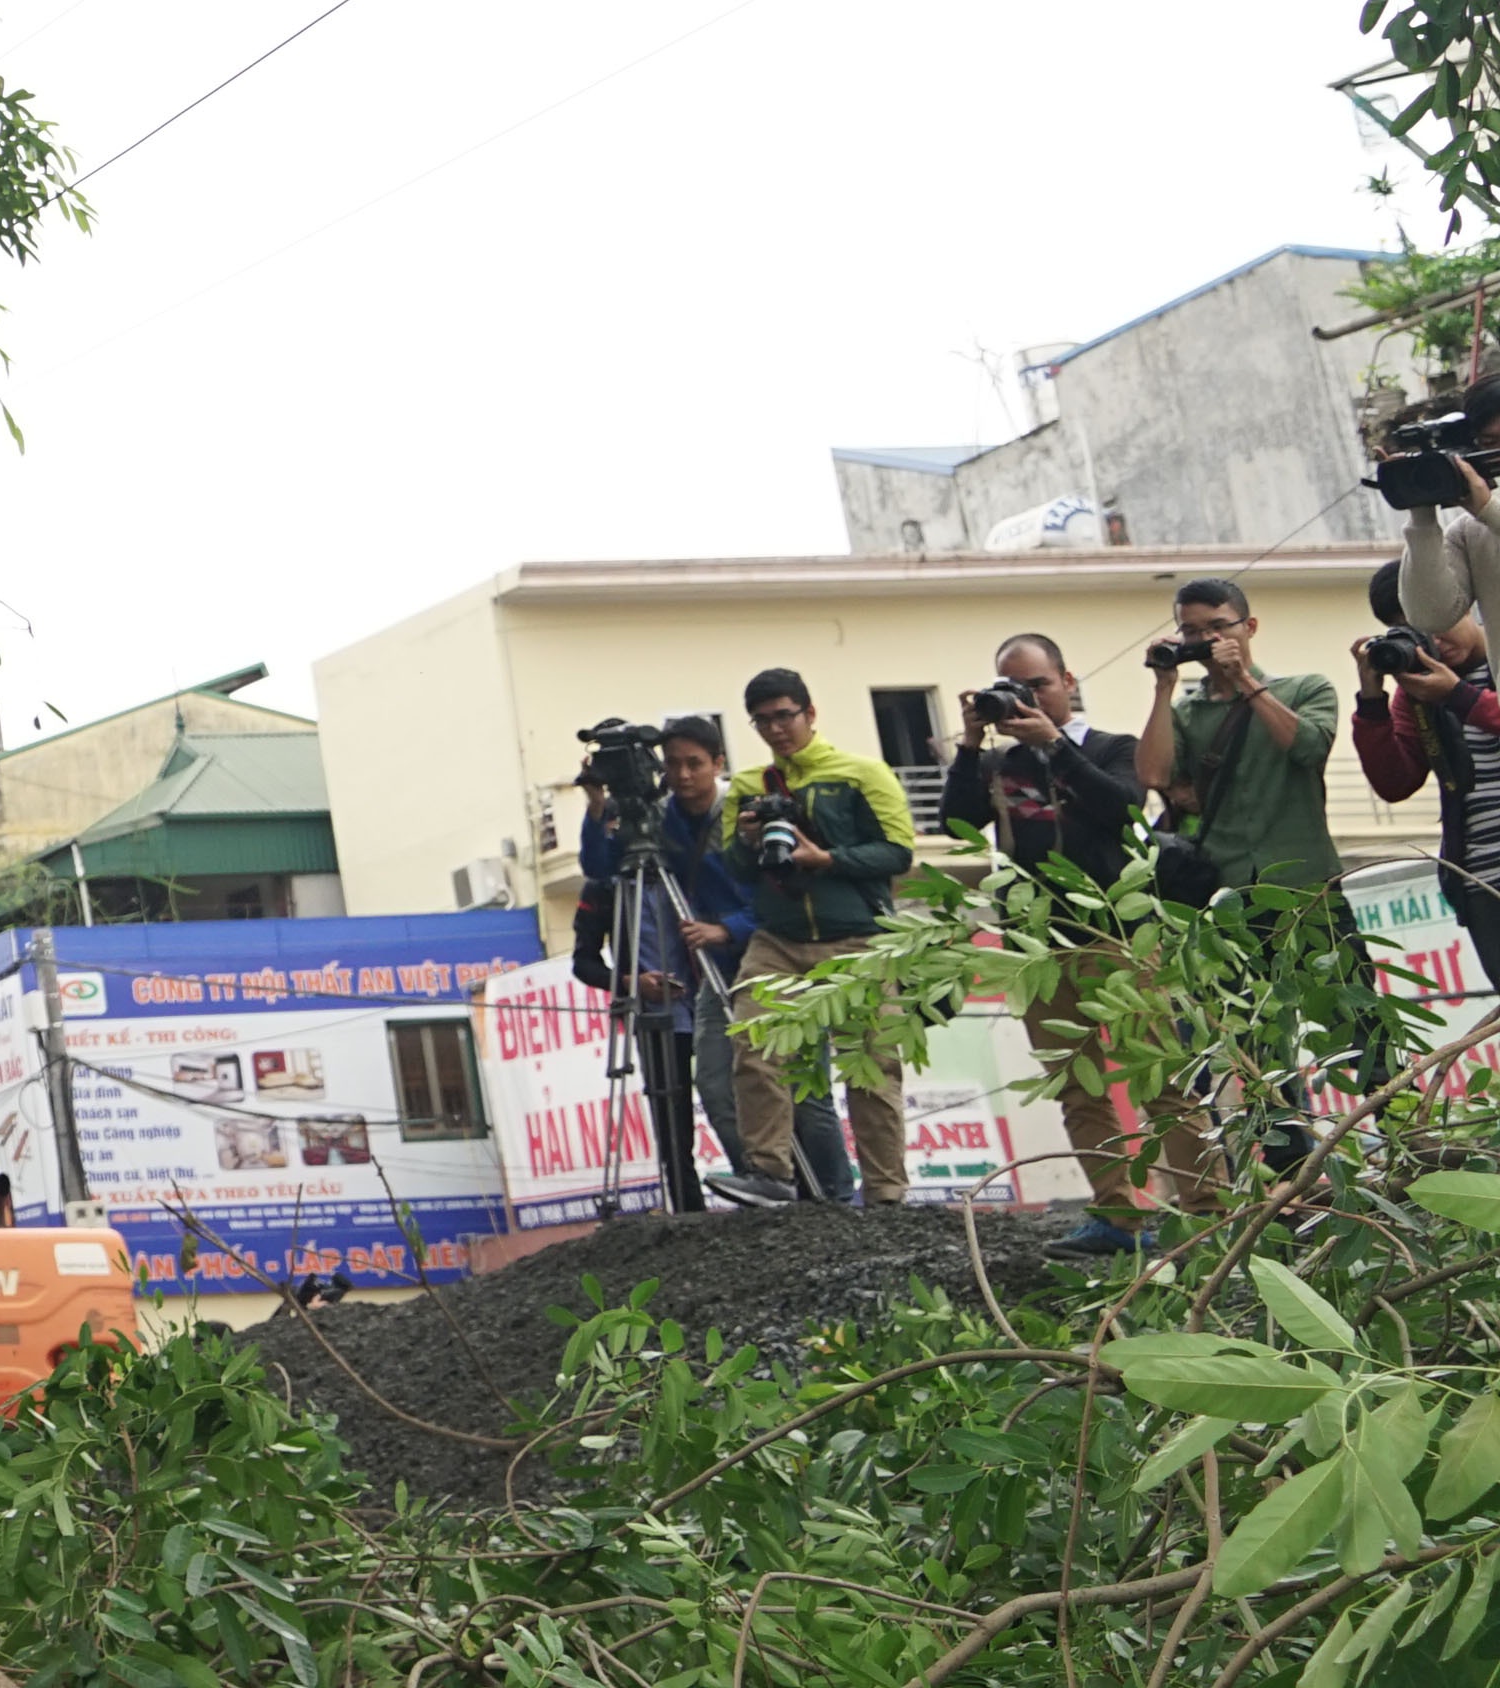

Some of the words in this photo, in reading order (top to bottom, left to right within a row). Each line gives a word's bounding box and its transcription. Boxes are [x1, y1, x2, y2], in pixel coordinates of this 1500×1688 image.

[358, 966, 396, 994] AN
[397, 959, 451, 998] VIỆT
[495, 976, 562, 1071] ĐIỆN
